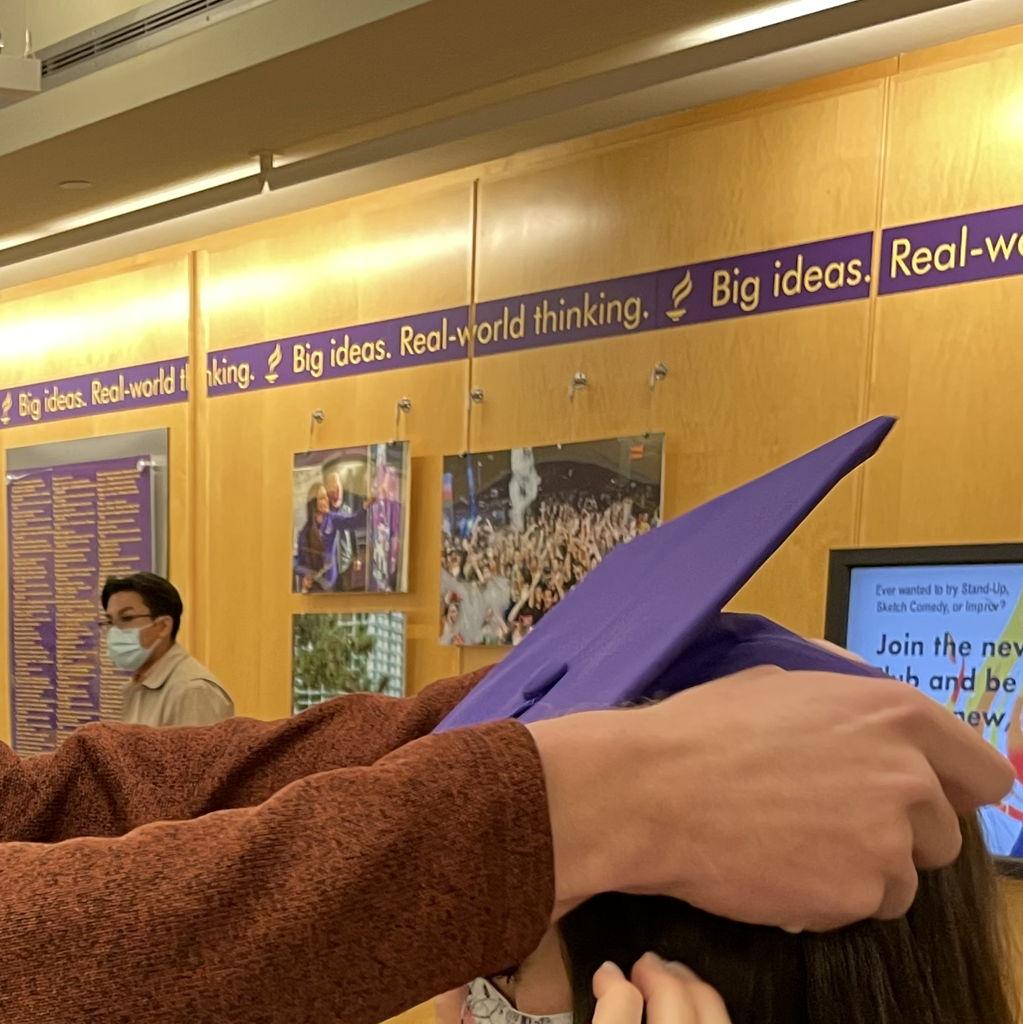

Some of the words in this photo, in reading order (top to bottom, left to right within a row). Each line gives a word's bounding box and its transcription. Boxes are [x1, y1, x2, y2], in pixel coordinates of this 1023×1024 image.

[712, 267, 760, 312] Big
[773, 254, 871, 298] ideas.
[292, 344, 324, 378] Big
[330, 335, 391, 368] ideas.
[400, 304, 525, 357] Real-world
[533, 292, 649, 335] thinking.
[19, 391, 42, 421] Big
[44, 387, 87, 413] ideas.
[92, 366, 175, 405] Real-world
[876, 583, 896, 596] Ever
[898, 584, 931, 596] wanted
[934, 584, 944, 596] to
[946, 584, 958, 598] try
[877, 601, 907, 613] Sketch
[952, 604, 962, 613] or
[876, 632, 924, 656] Join
[934, 631, 972, 657] the
[929, 668, 976, 691] and
[986, 668, 1016, 692] be
